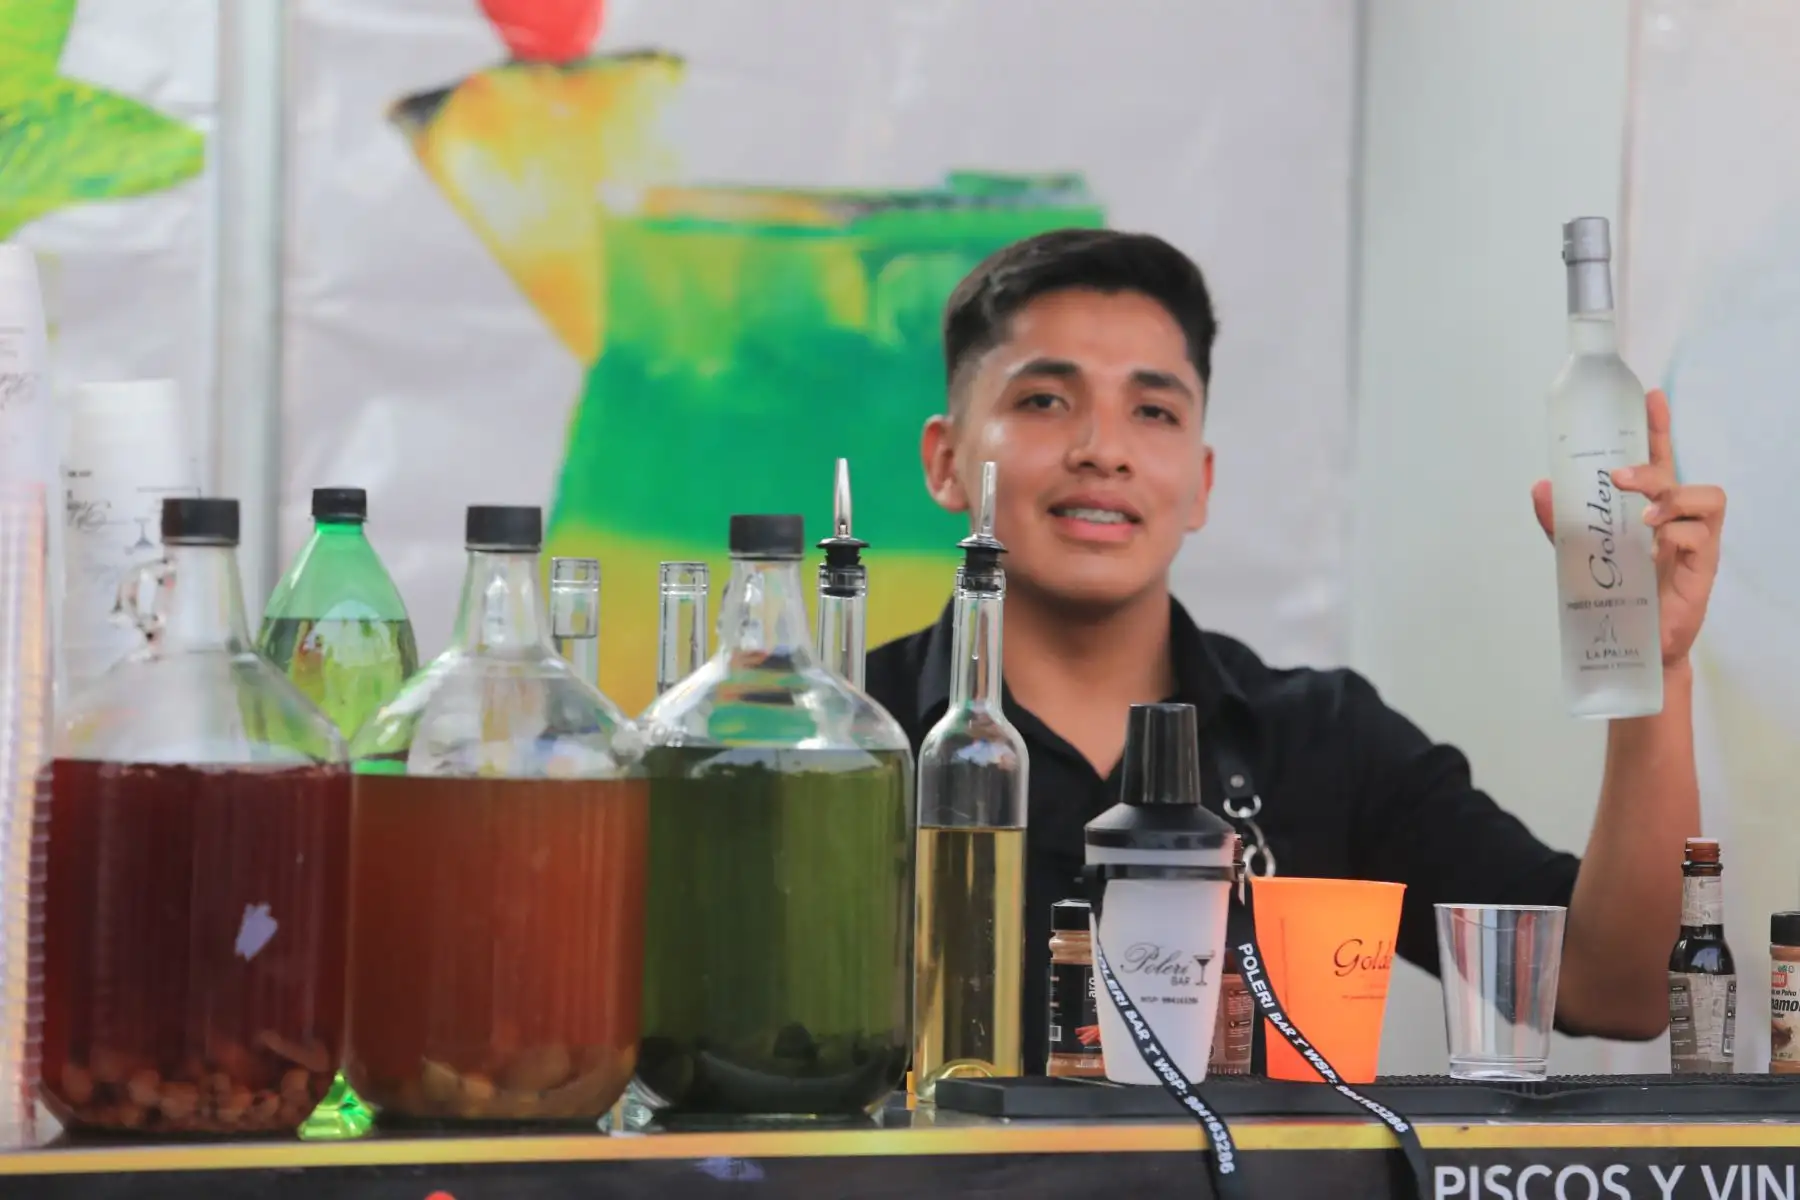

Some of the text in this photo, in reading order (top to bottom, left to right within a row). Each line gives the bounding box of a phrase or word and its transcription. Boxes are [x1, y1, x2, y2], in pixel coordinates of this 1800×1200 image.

[1586, 468, 1623, 590] Golden
[1120, 942, 1192, 975] Poleri
[1170, 975, 1191, 987] BAR
[1124, 1009, 1151, 1041] BAR
[1238, 943, 1275, 1009] POLERI
[1268, 1012, 1296, 1038] BAR
[1304, 1049, 1338, 1084] WSP:
[1434, 1164, 1632, 1200] PISCOS
[1648, 1164, 1686, 1200] Y
